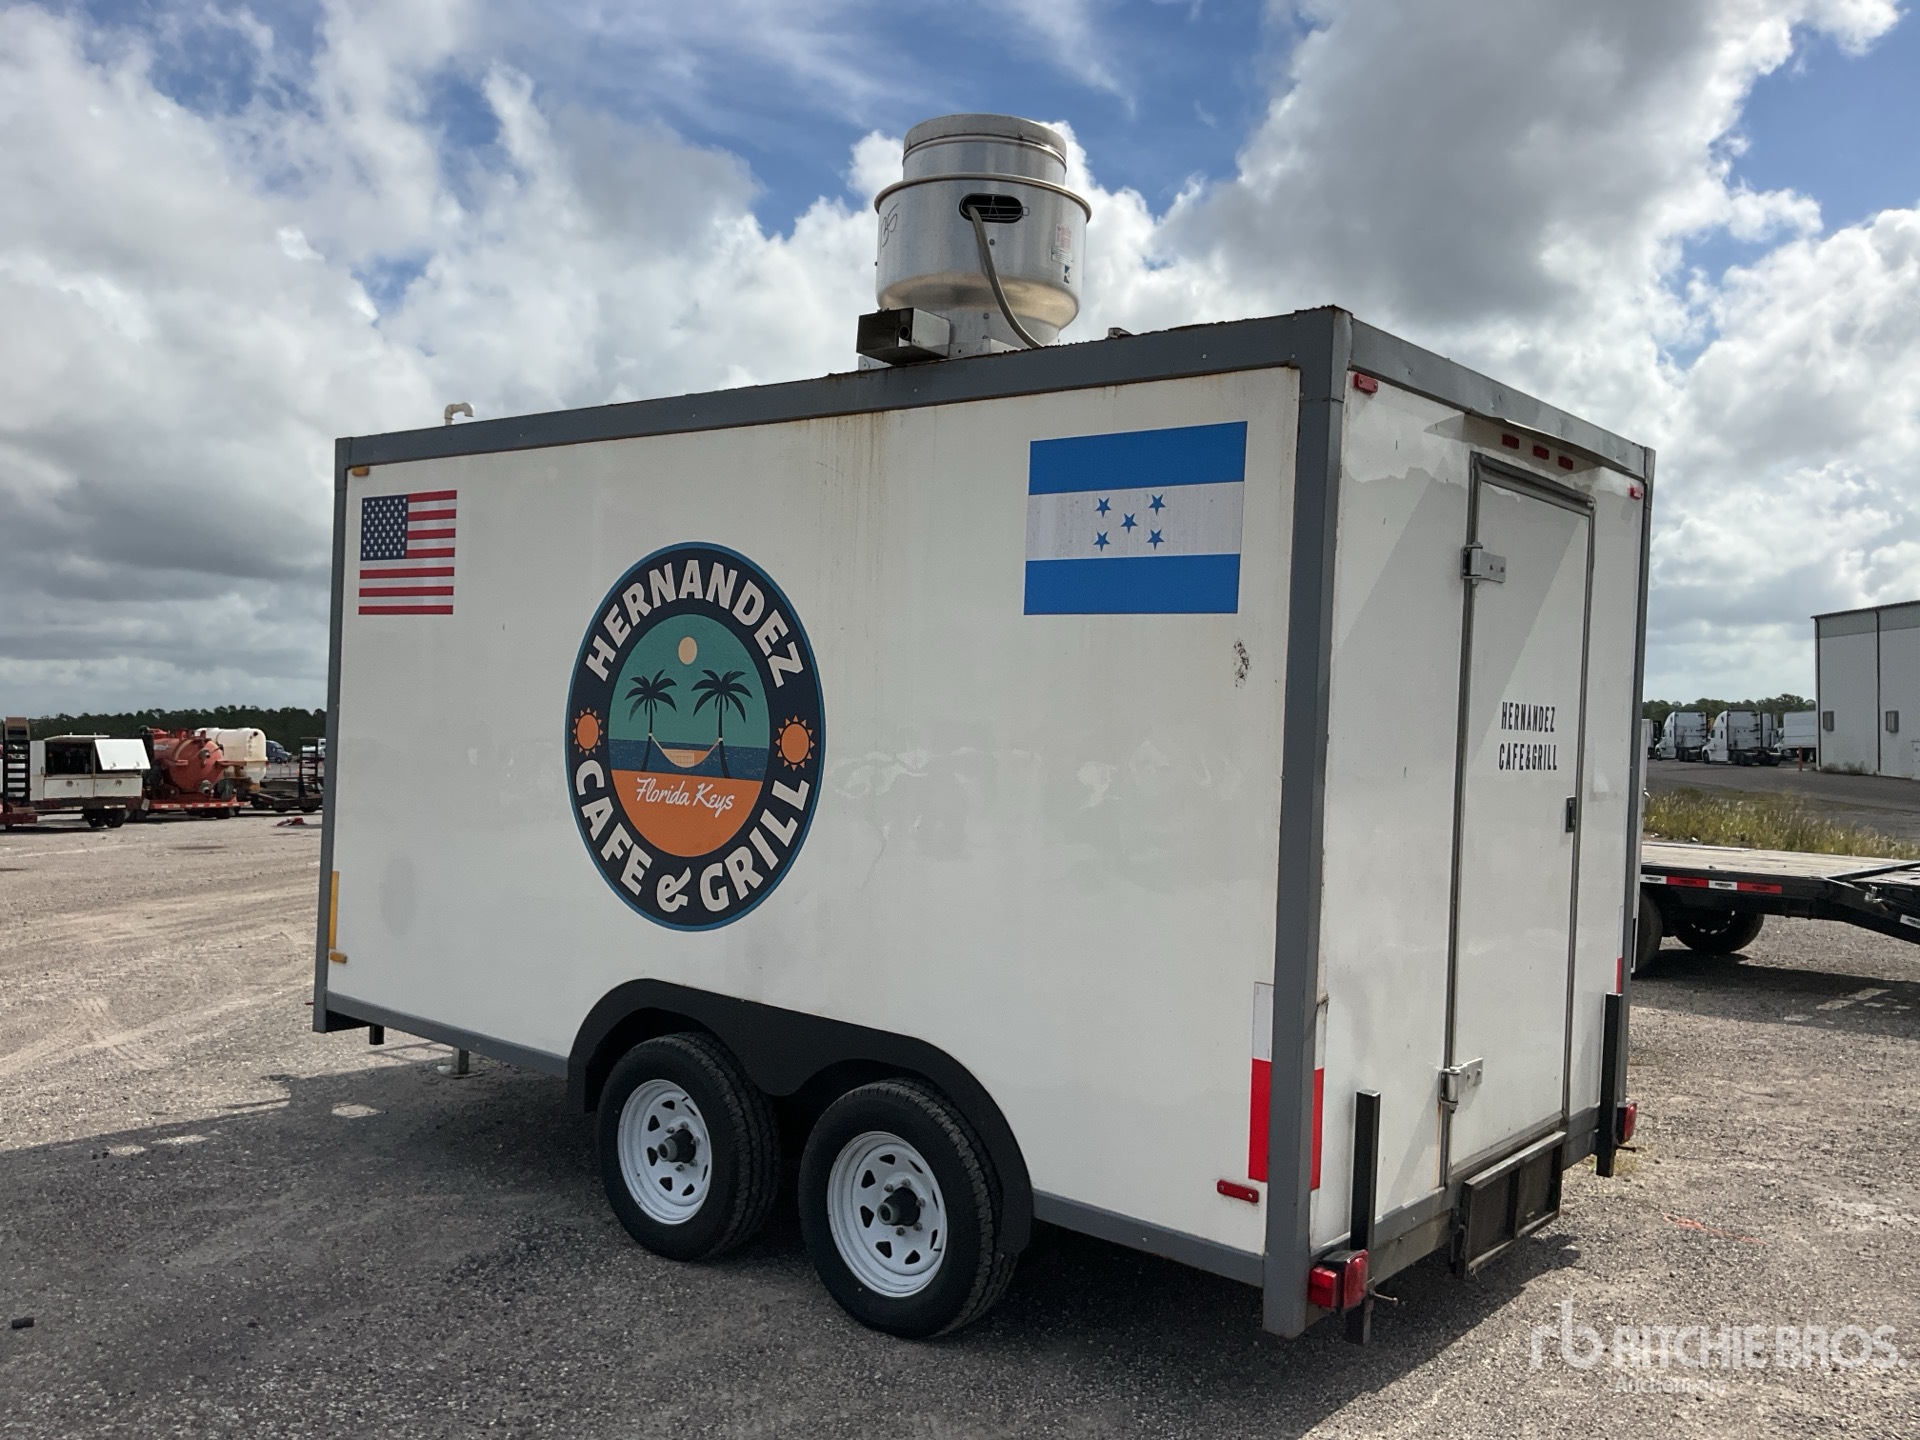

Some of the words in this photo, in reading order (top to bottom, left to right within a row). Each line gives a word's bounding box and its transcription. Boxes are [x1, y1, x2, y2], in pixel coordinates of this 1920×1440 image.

[585, 559, 804, 688] HERNANDEZ
[1501, 701, 1556, 733] HERNANDEZ
[1498, 742, 1558, 771] CAFE&GRILL
[636, 777, 691, 806] Florida
[692, 782, 735, 819] Keys
[575, 759, 653, 896] CAFE
[656, 866, 692, 913] &
[699, 779, 811, 912] GRILL
